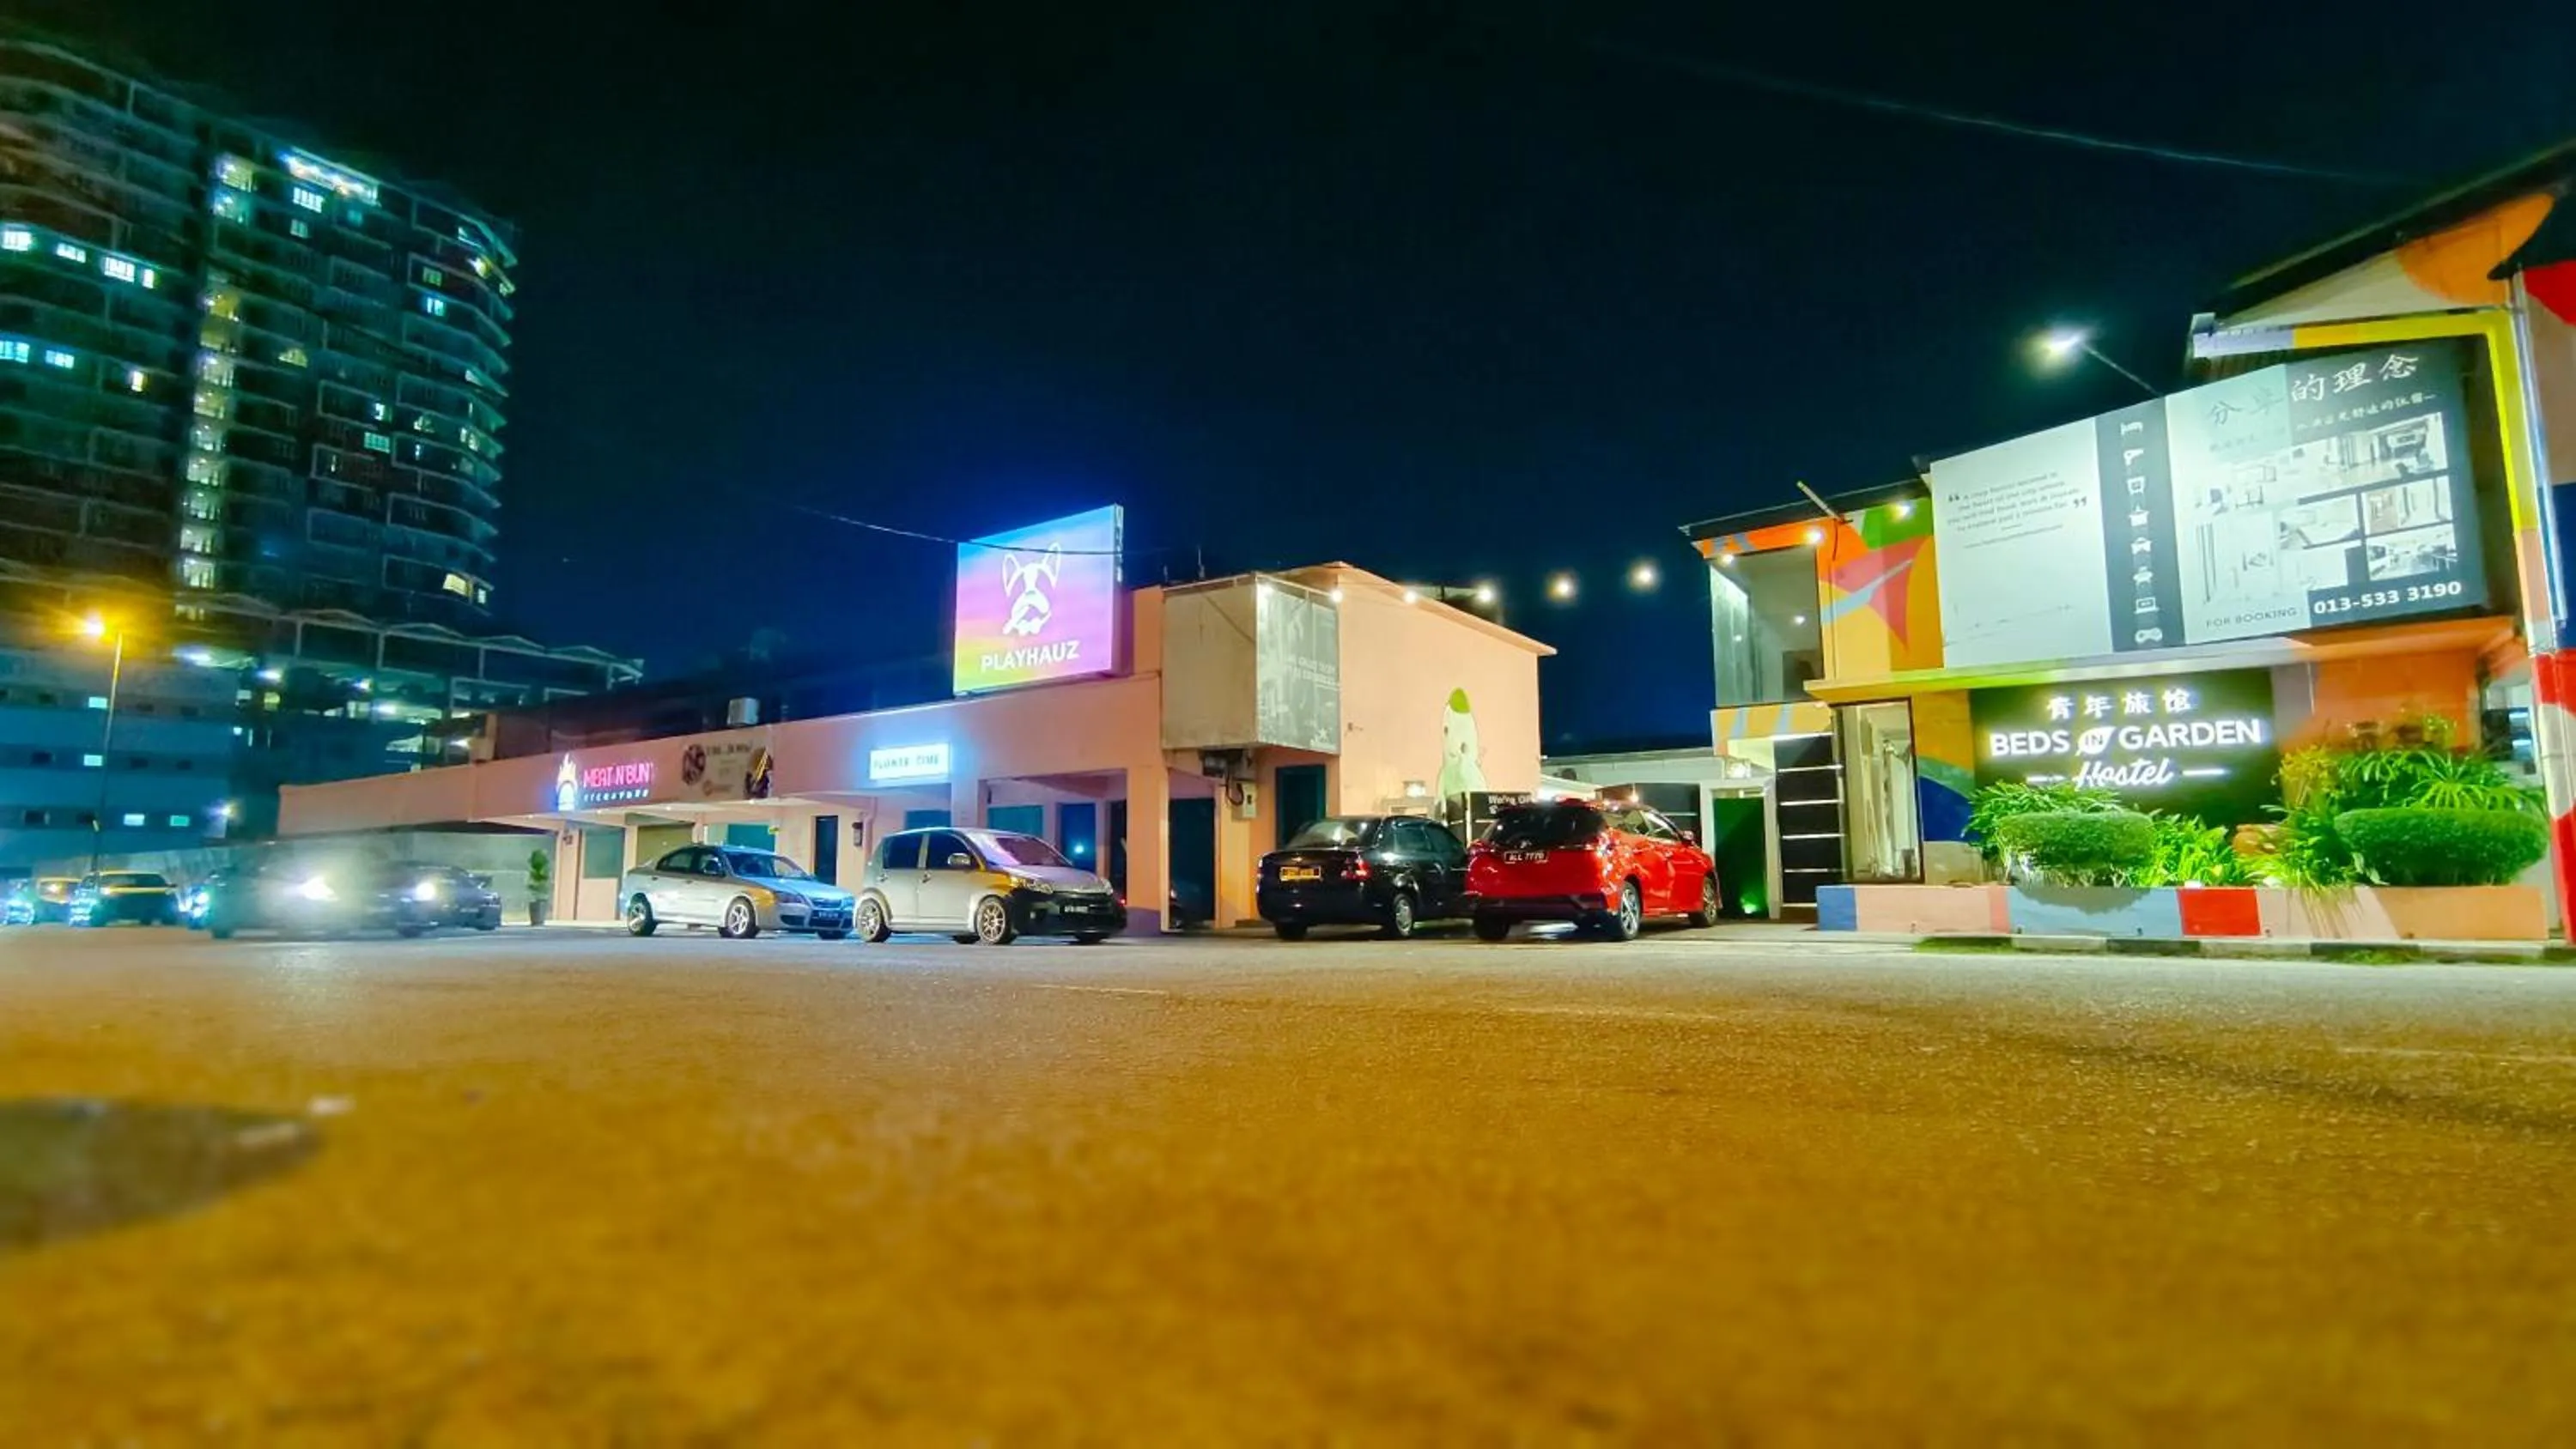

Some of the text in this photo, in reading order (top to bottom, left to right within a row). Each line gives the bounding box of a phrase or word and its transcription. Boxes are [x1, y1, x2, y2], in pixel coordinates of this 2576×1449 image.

[2206, 580, 2462, 629] FOR BOOKING 013-533 3190
[981, 640, 1080, 673] PLAYHAUZ
[1989, 730, 2071, 757] BEDS
[2117, 718, 2262, 750] GARDEN
[2071, 757, 2174, 791] Hostel
